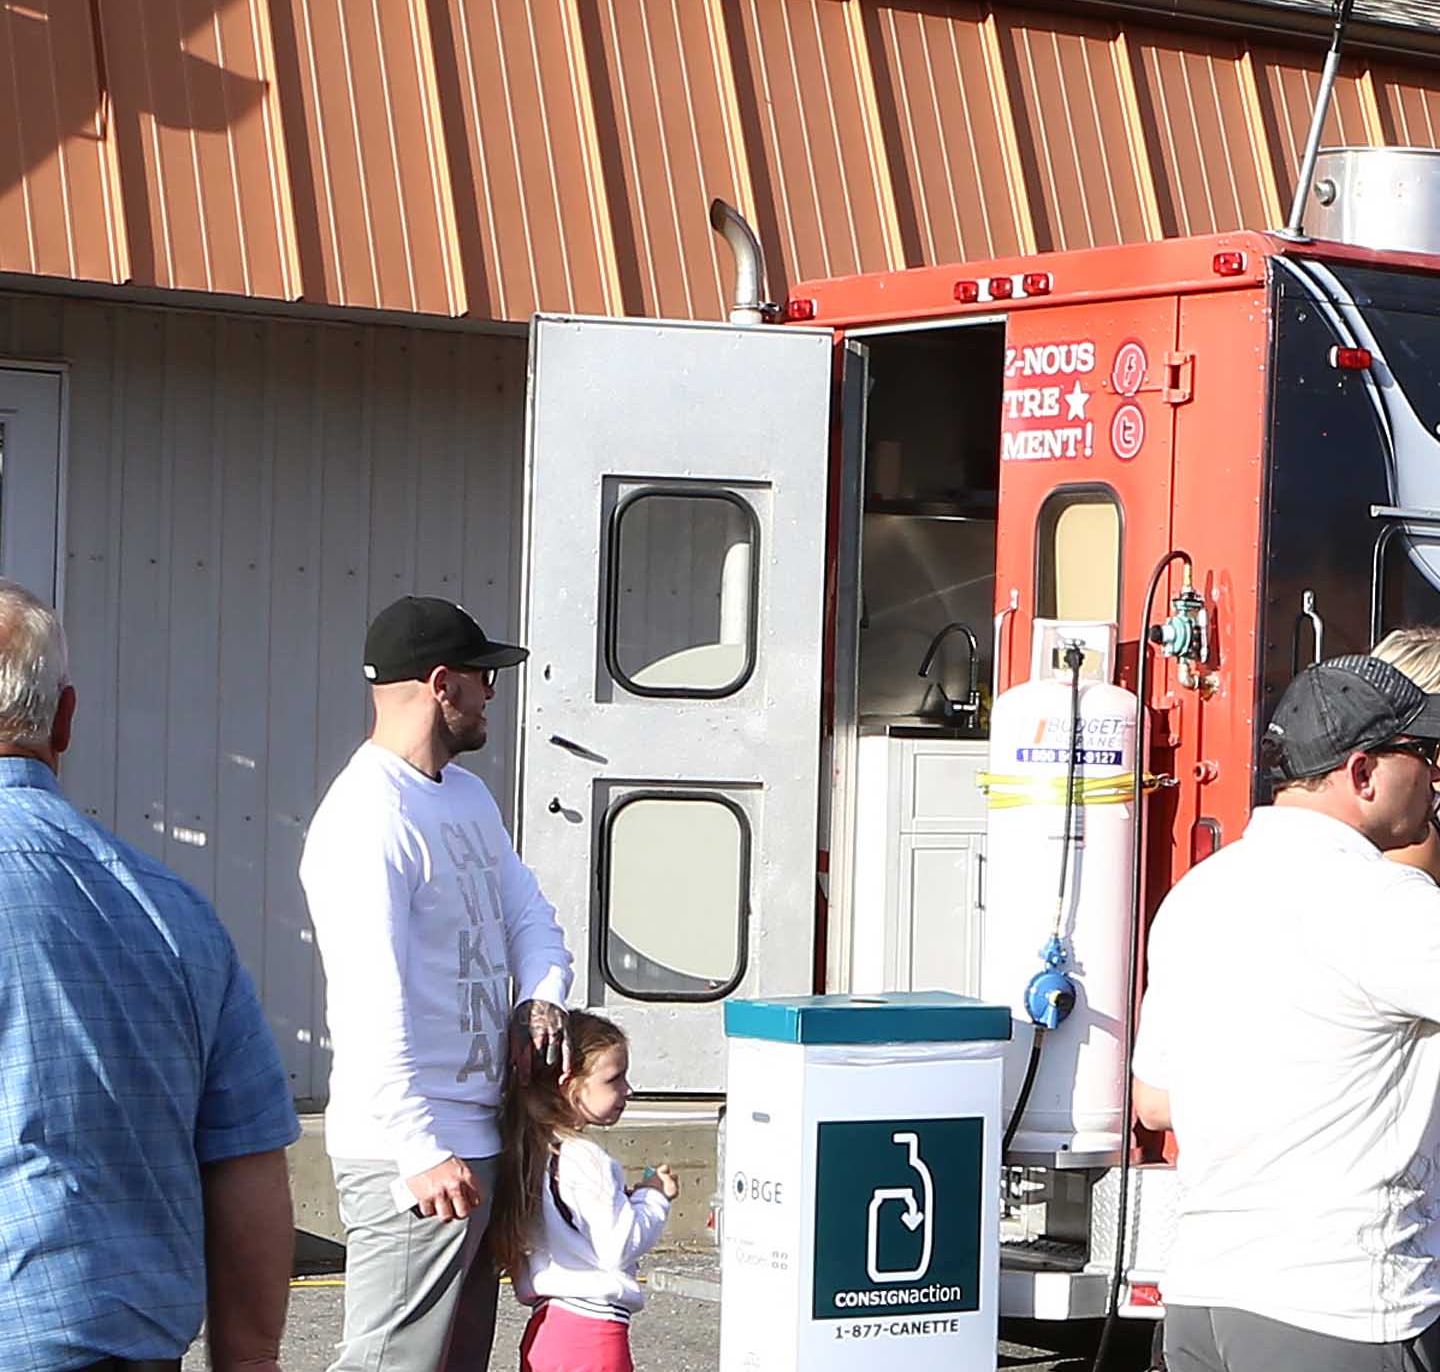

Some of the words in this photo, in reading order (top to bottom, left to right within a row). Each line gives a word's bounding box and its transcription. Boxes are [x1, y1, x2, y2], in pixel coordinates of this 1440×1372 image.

[750, 1178, 783, 1205] BGE
[834, 1284, 961, 1308] CONSIGNaction
[834, 1318, 960, 1340] 1-877-CANETTE
